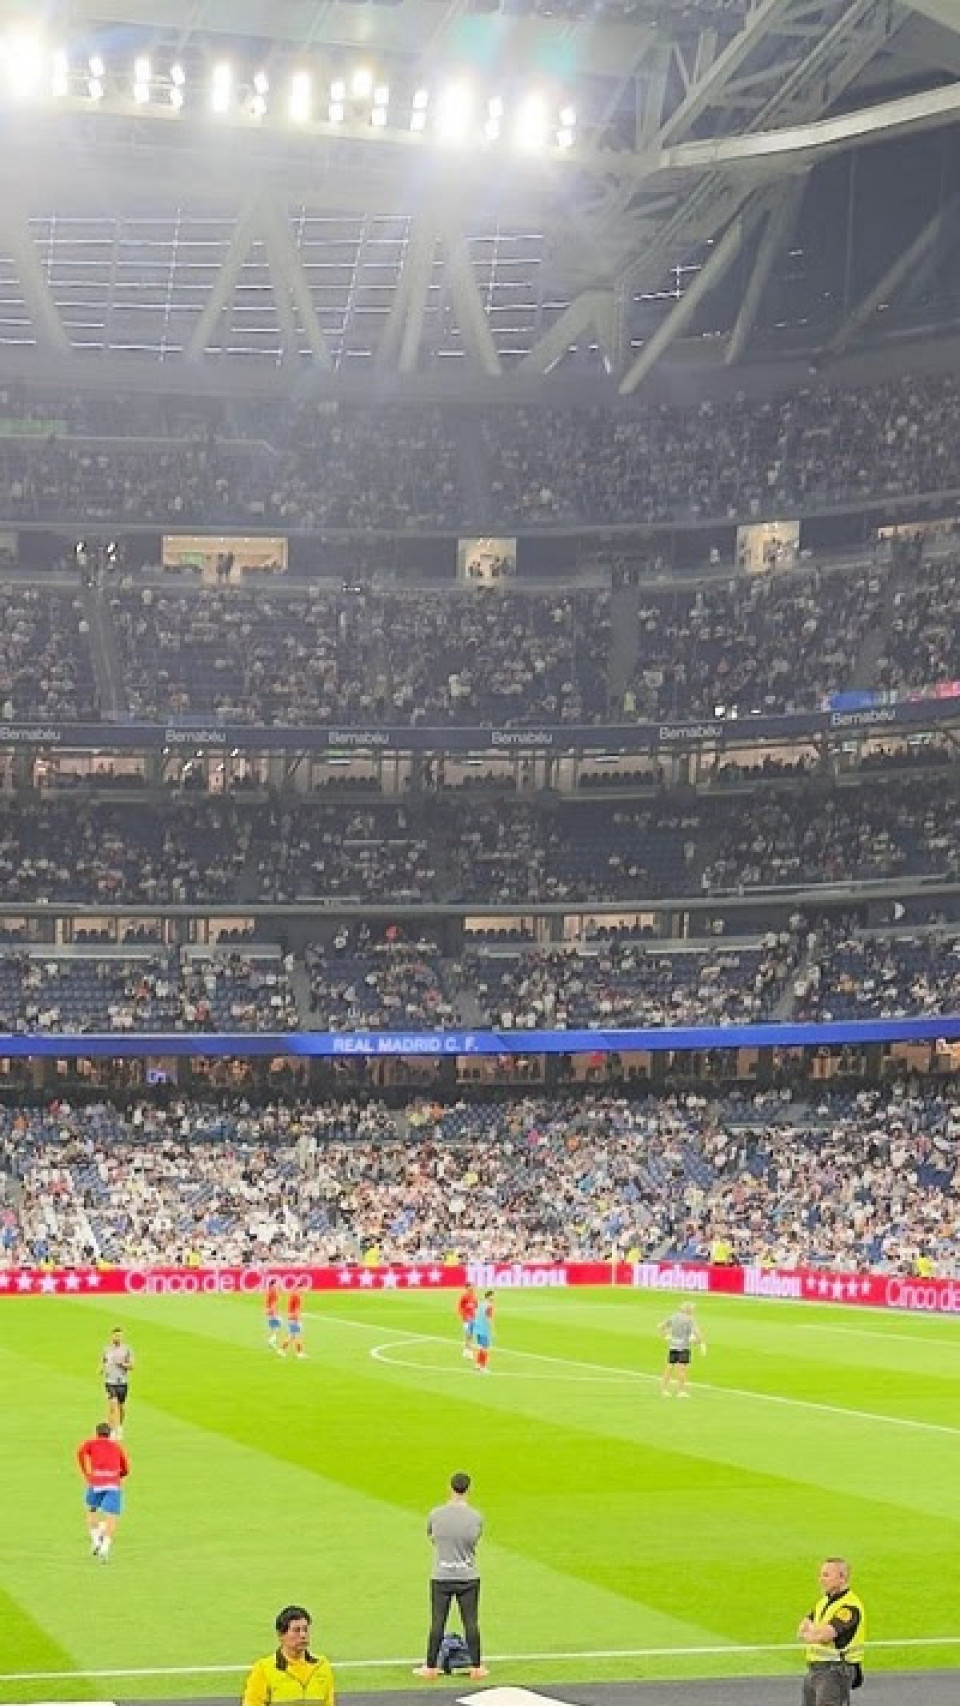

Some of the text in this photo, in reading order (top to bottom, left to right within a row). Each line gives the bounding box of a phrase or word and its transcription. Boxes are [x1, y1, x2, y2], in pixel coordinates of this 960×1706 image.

[333, 1038, 374, 1051] REAL
[378, 1038, 439, 1051] MADRID
[125, 1269, 198, 1294] Cinco
[203, 1267, 237, 1294] de
[465, 1265, 567, 1287] Mahou
[633, 1264, 708, 1291] Mahou
